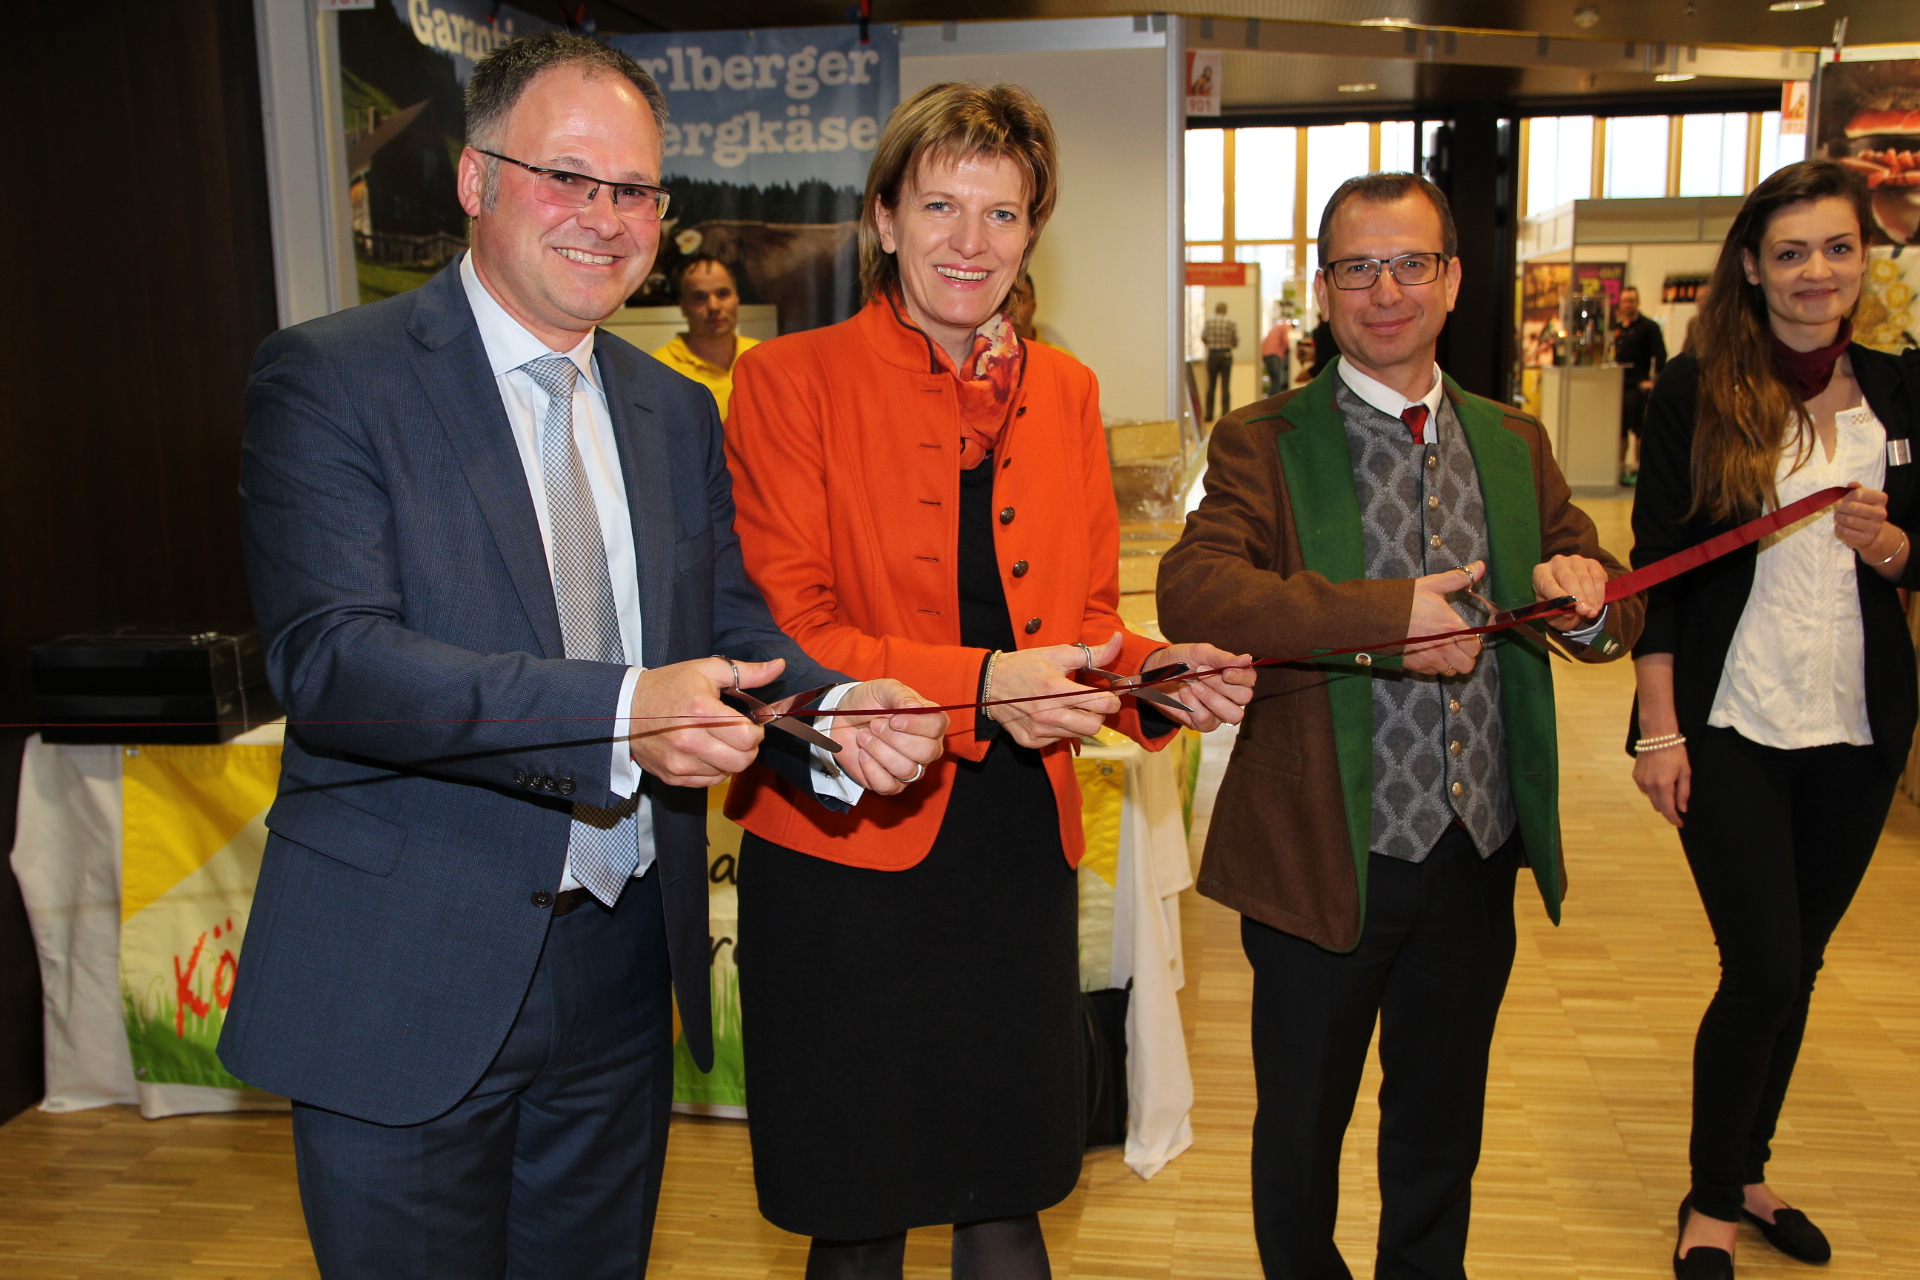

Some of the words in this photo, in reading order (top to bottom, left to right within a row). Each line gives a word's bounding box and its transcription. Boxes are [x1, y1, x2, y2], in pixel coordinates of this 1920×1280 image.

[637, 46, 879, 99] rlberger
[664, 104, 878, 168] ergkäse
[173, 918, 238, 1039] Kö
